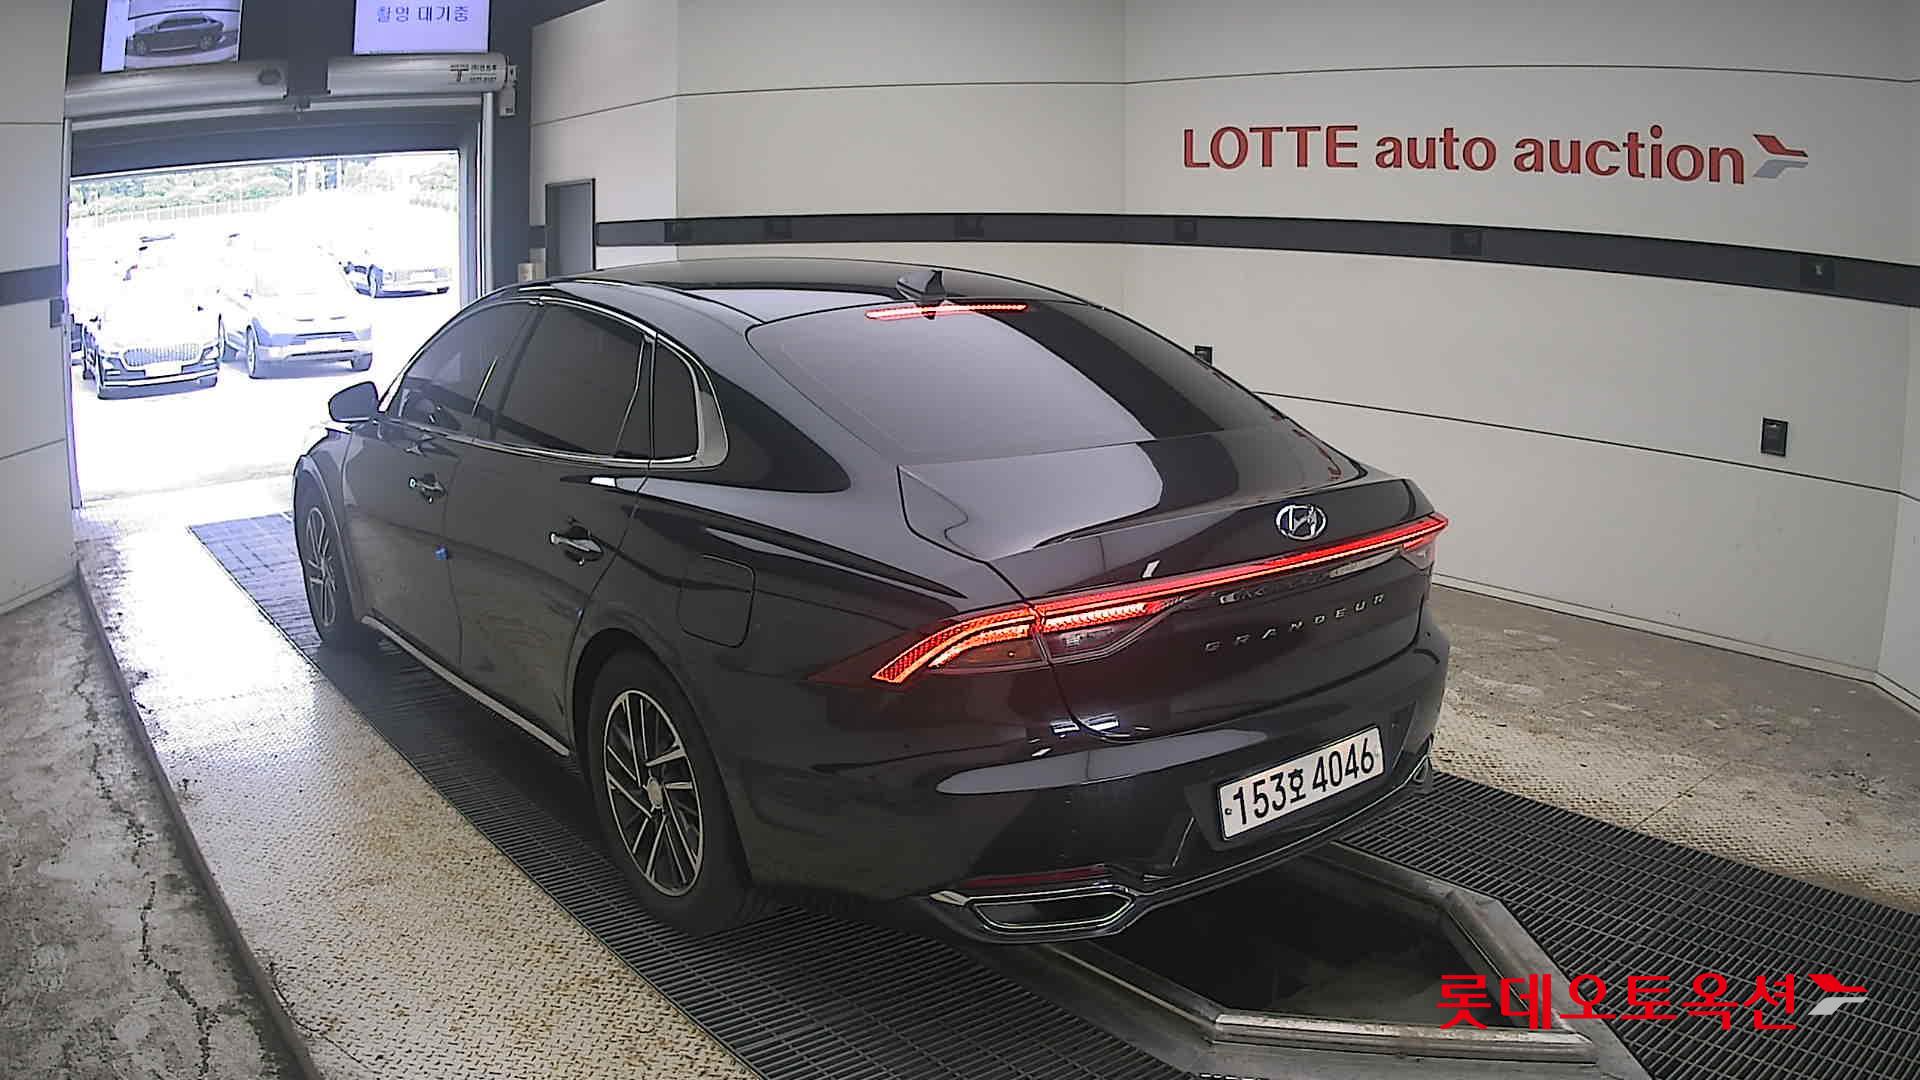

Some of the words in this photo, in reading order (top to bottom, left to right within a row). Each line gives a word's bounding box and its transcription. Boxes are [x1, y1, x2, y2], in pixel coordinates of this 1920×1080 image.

[418, 6, 469, 23] 대기중
[1184, 125, 1359, 169] LOTTE
[1375, 127, 1497, 171] auto
[1514, 124, 1745, 185] auction
[1204, 593, 1385, 652] GRANDEUR
[1233, 768, 1306, 825] 153호
[1312, 738, 1375, 793] 4046
